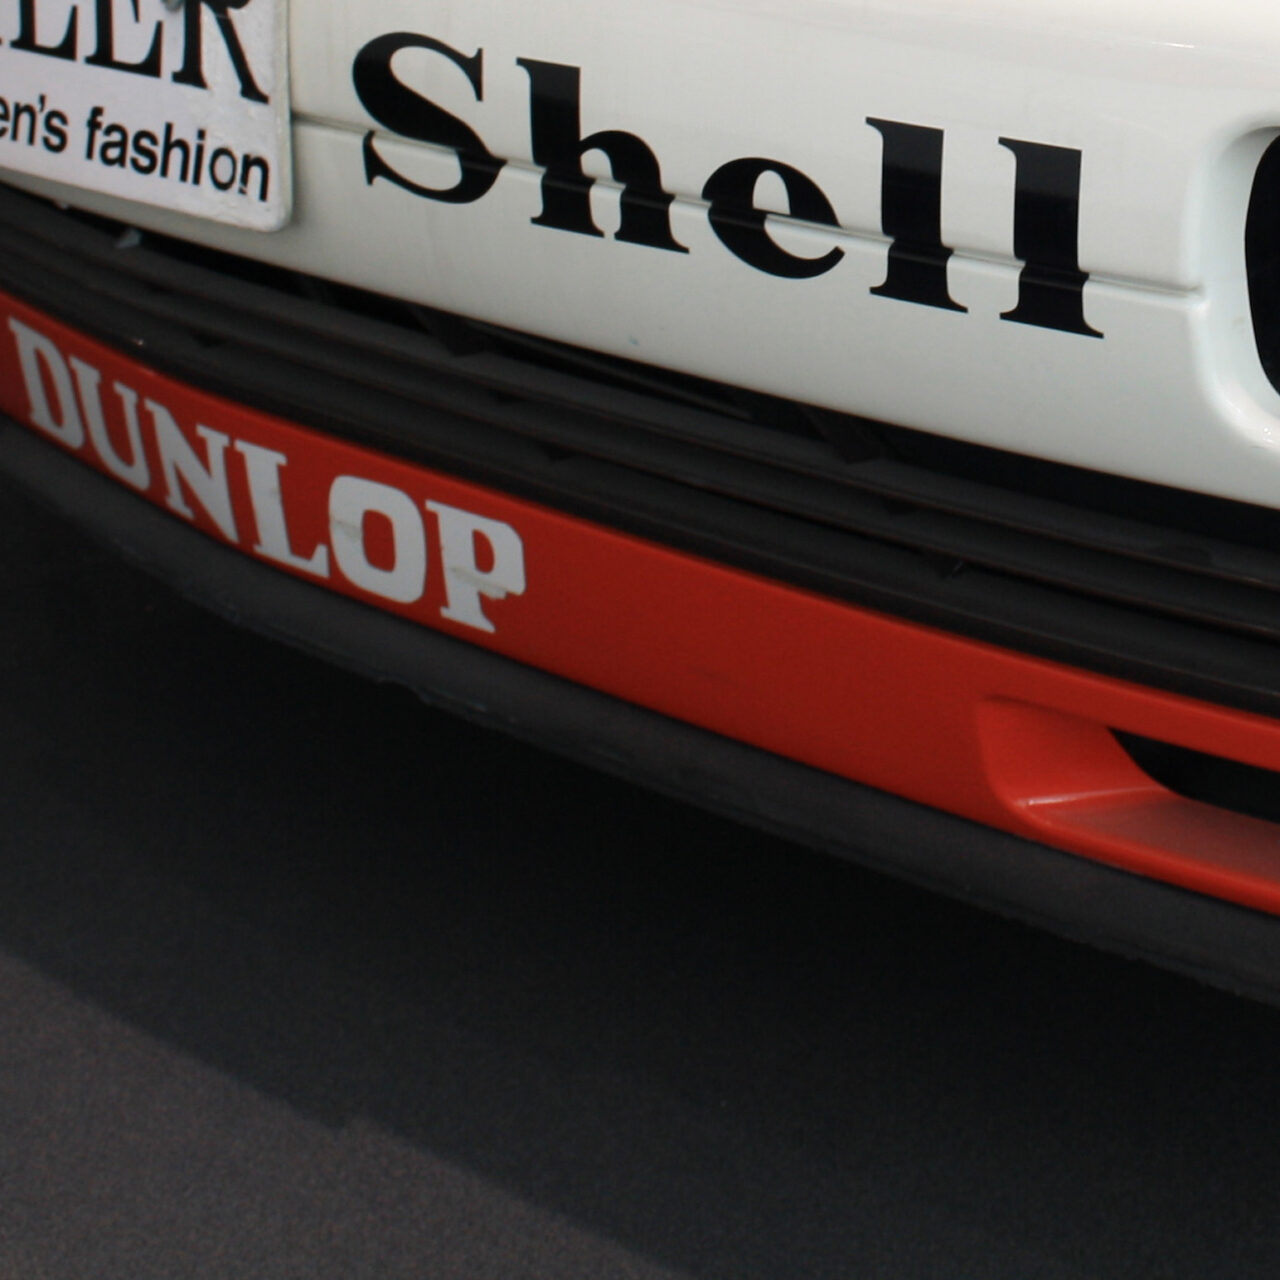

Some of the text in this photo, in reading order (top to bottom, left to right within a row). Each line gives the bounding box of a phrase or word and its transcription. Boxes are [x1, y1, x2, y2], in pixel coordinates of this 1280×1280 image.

[85, 105, 270, 203] fashion
[352, 30, 1105, 340] Shell
[8, 314, 527, 634] DUNLOP
